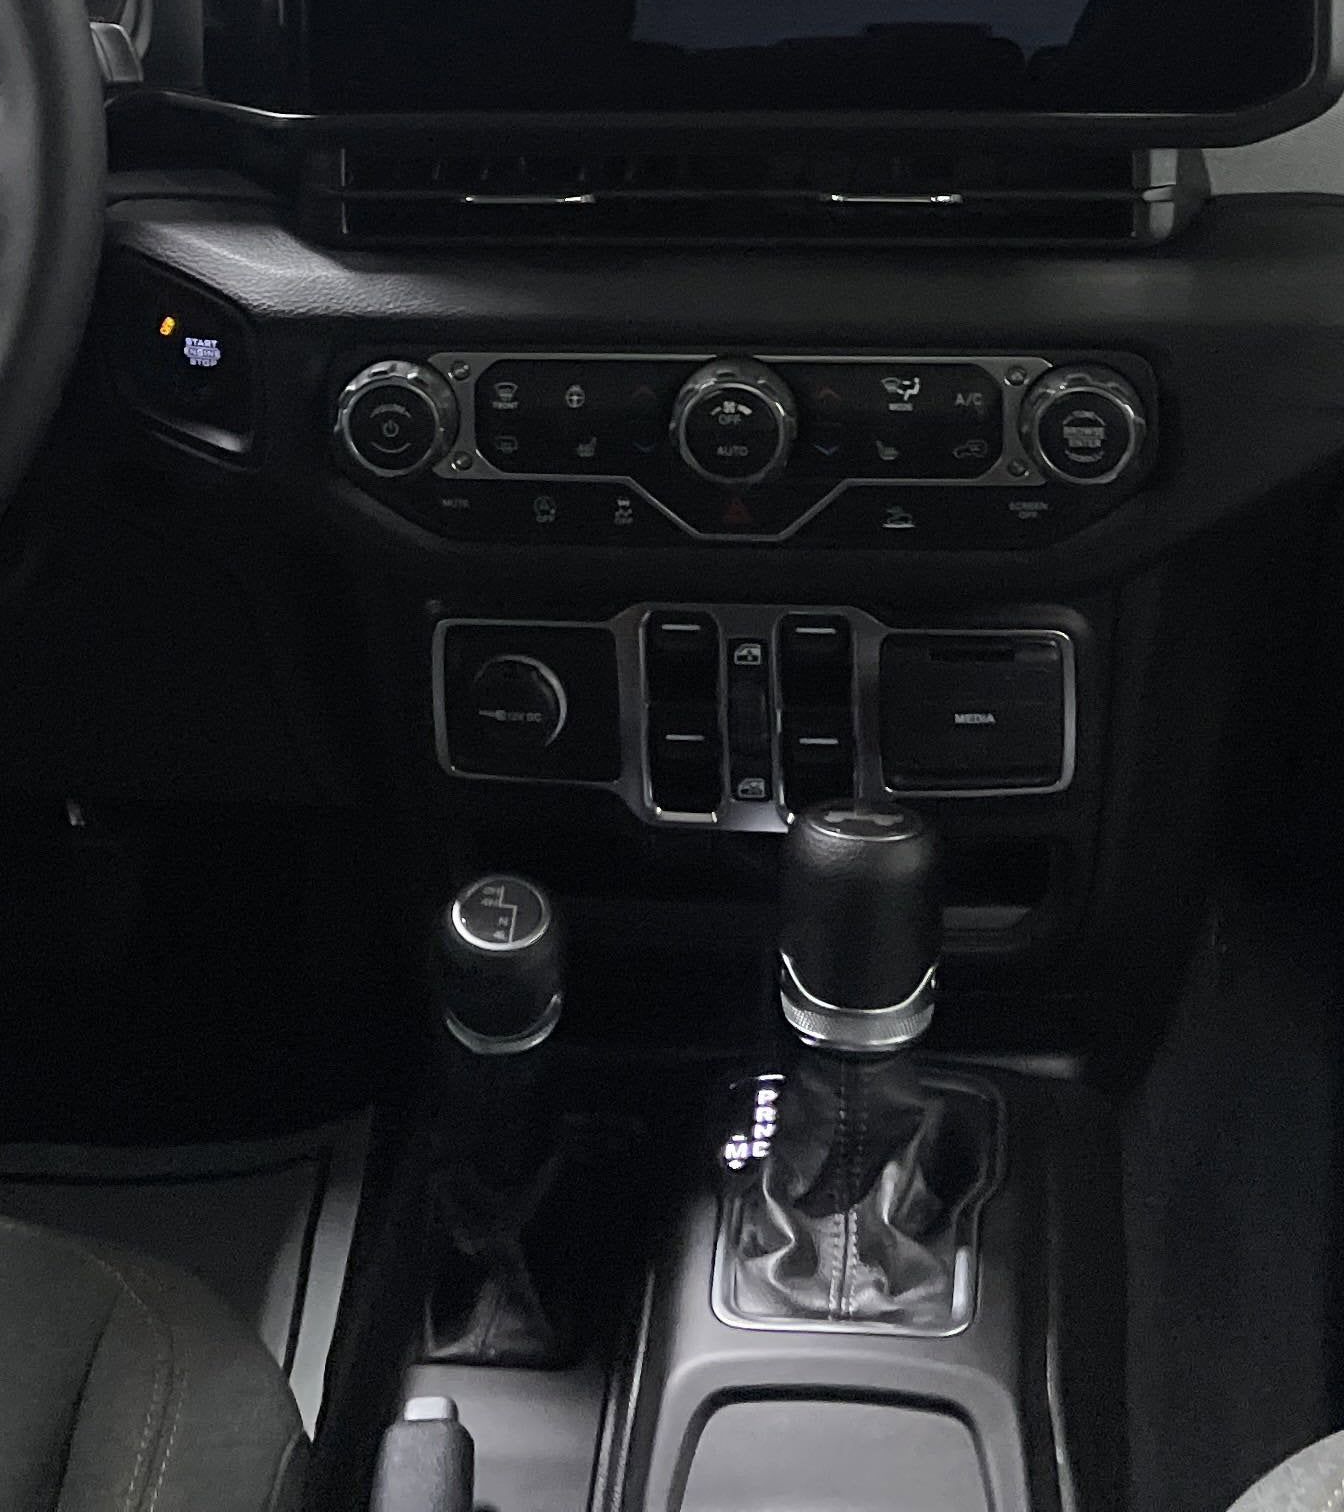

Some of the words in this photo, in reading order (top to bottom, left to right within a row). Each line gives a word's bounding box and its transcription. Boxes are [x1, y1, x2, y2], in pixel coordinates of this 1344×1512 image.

[955, 392, 983, 407] A/C
[718, 413, 742, 426] OFF
[716, 445, 749, 457] AUTO
[954, 712, 997, 725] MEDIA
[498, 916, 509, 928] N
[756, 1089, 778, 1106] P
[754, 1105, 777, 1122] R
[753, 1122, 776, 1140] N
[723, 1142, 748, 1160] M
